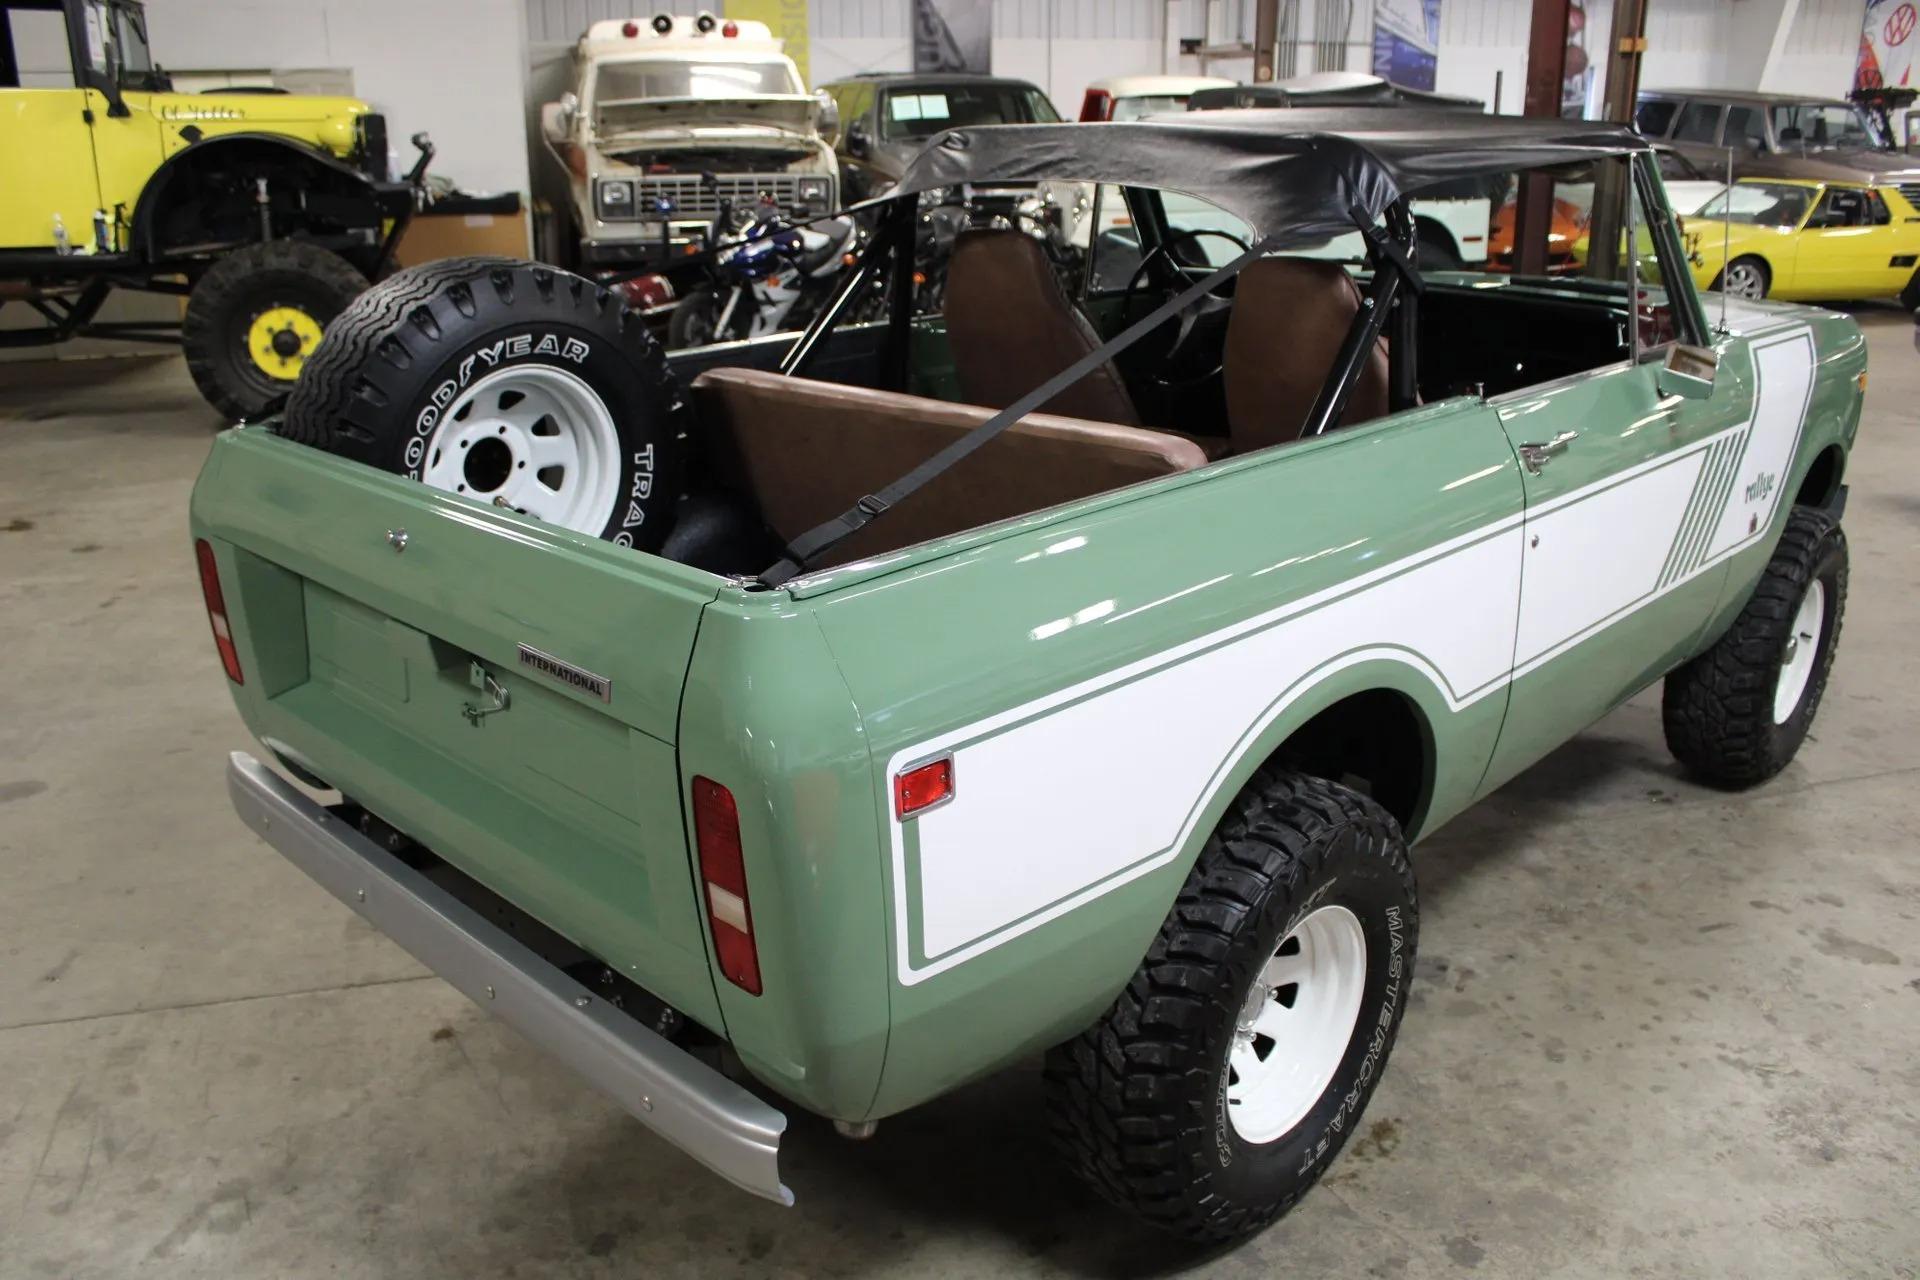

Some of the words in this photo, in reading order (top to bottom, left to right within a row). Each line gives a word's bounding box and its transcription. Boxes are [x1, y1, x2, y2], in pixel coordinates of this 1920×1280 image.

[402, 334, 589, 481] OODYEAR
[1745, 472, 1775, 504] rallye
[520, 649, 603, 696] INTERNATIONAL
[1298, 905, 1405, 1177] MASTERCRAFT
